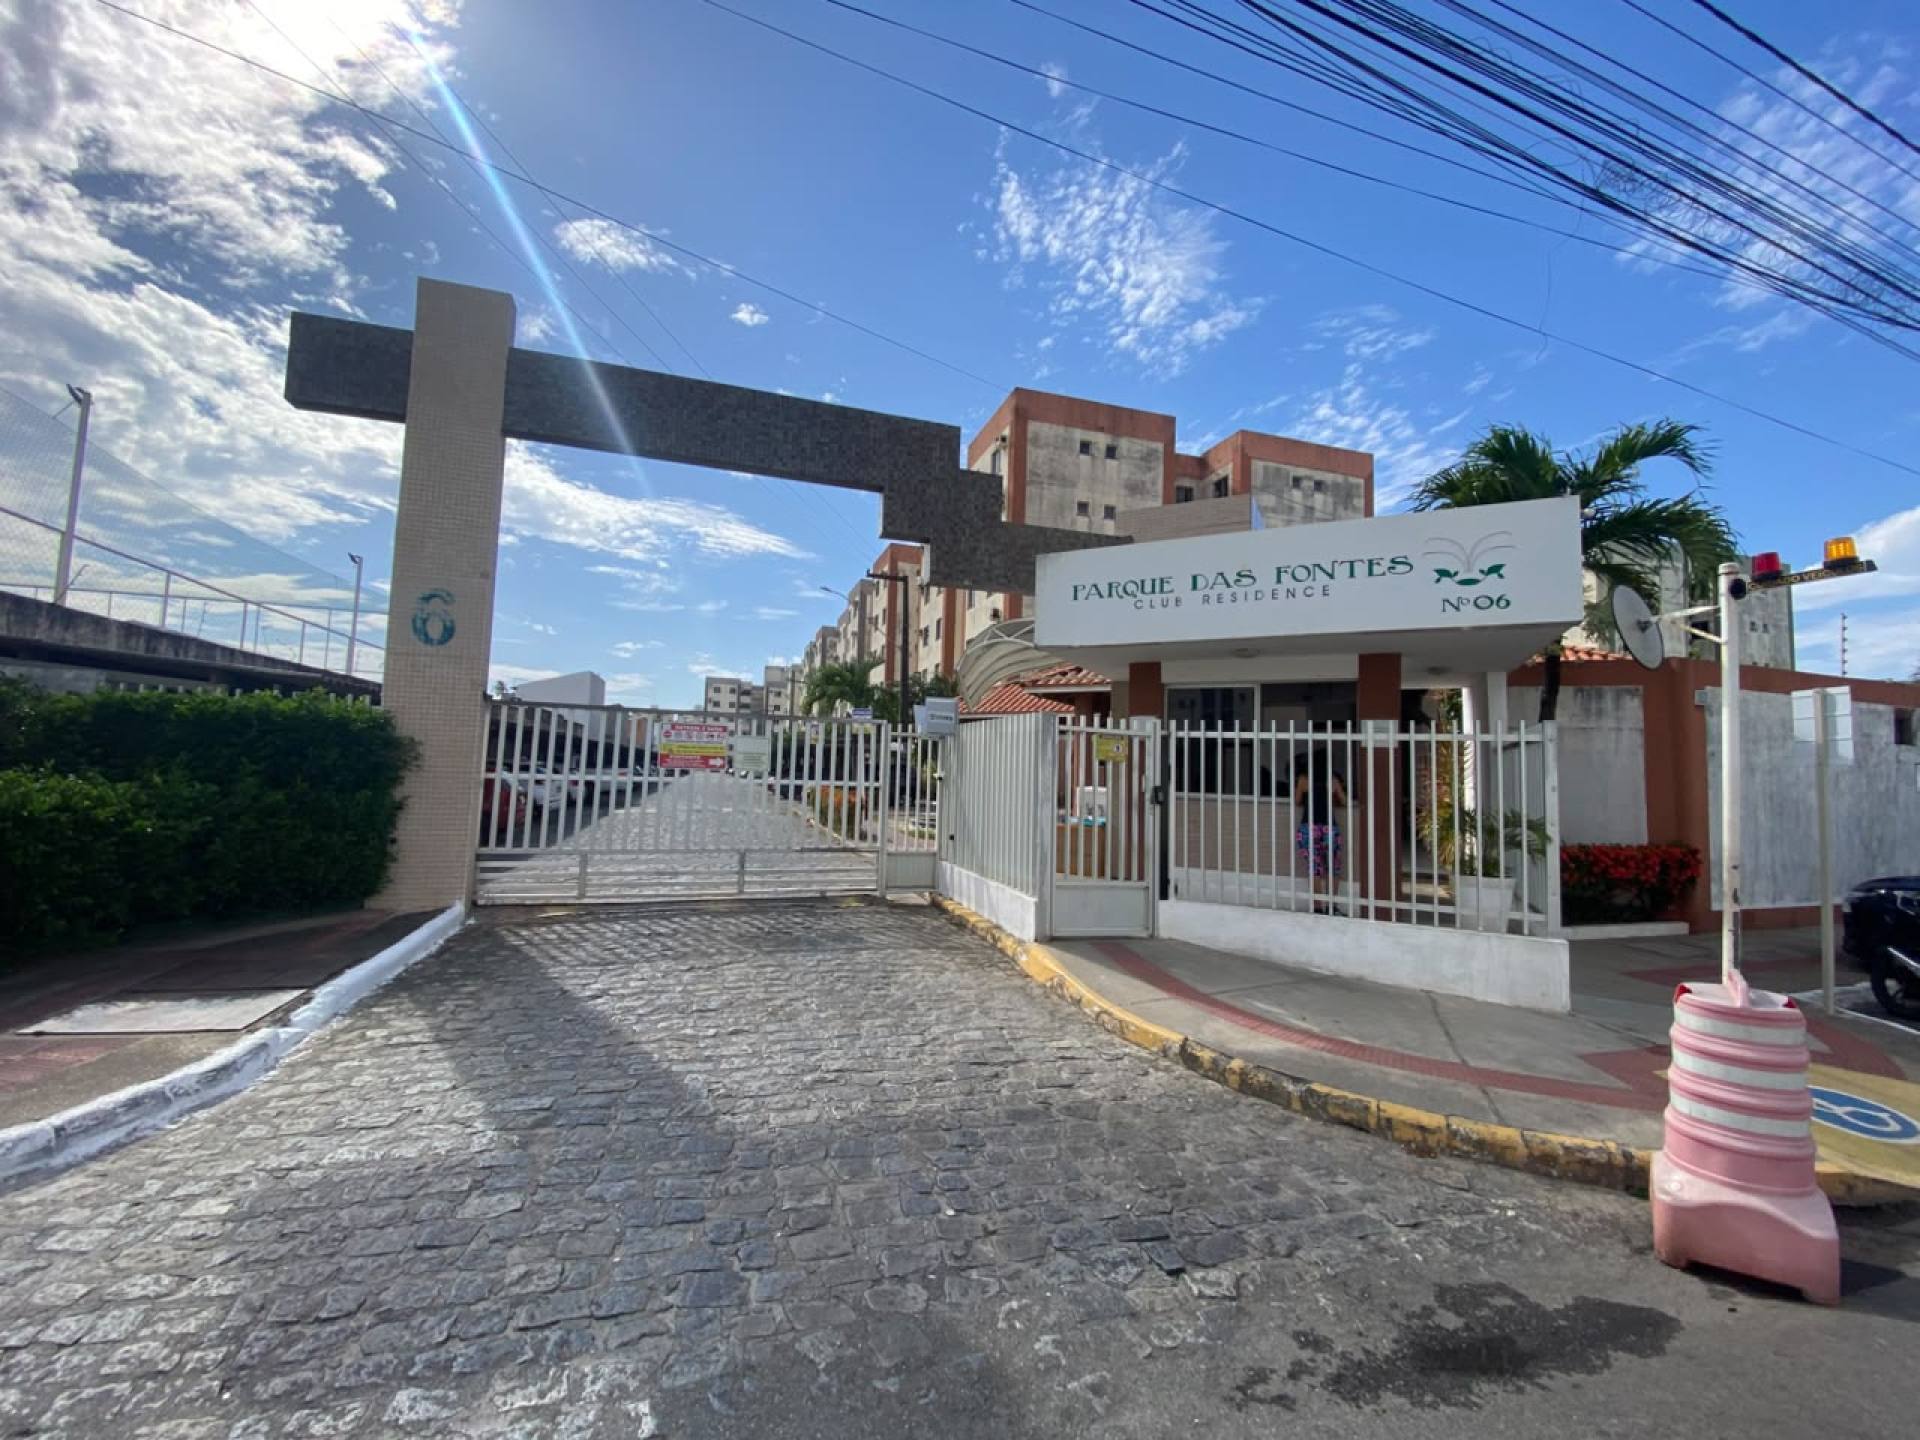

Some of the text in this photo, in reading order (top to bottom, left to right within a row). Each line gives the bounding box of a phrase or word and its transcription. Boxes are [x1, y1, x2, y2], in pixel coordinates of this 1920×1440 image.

[1072, 555, 1414, 601] PARQUE DAS FONTES
[1133, 584, 1331, 610] CLUB RESIDENCE
